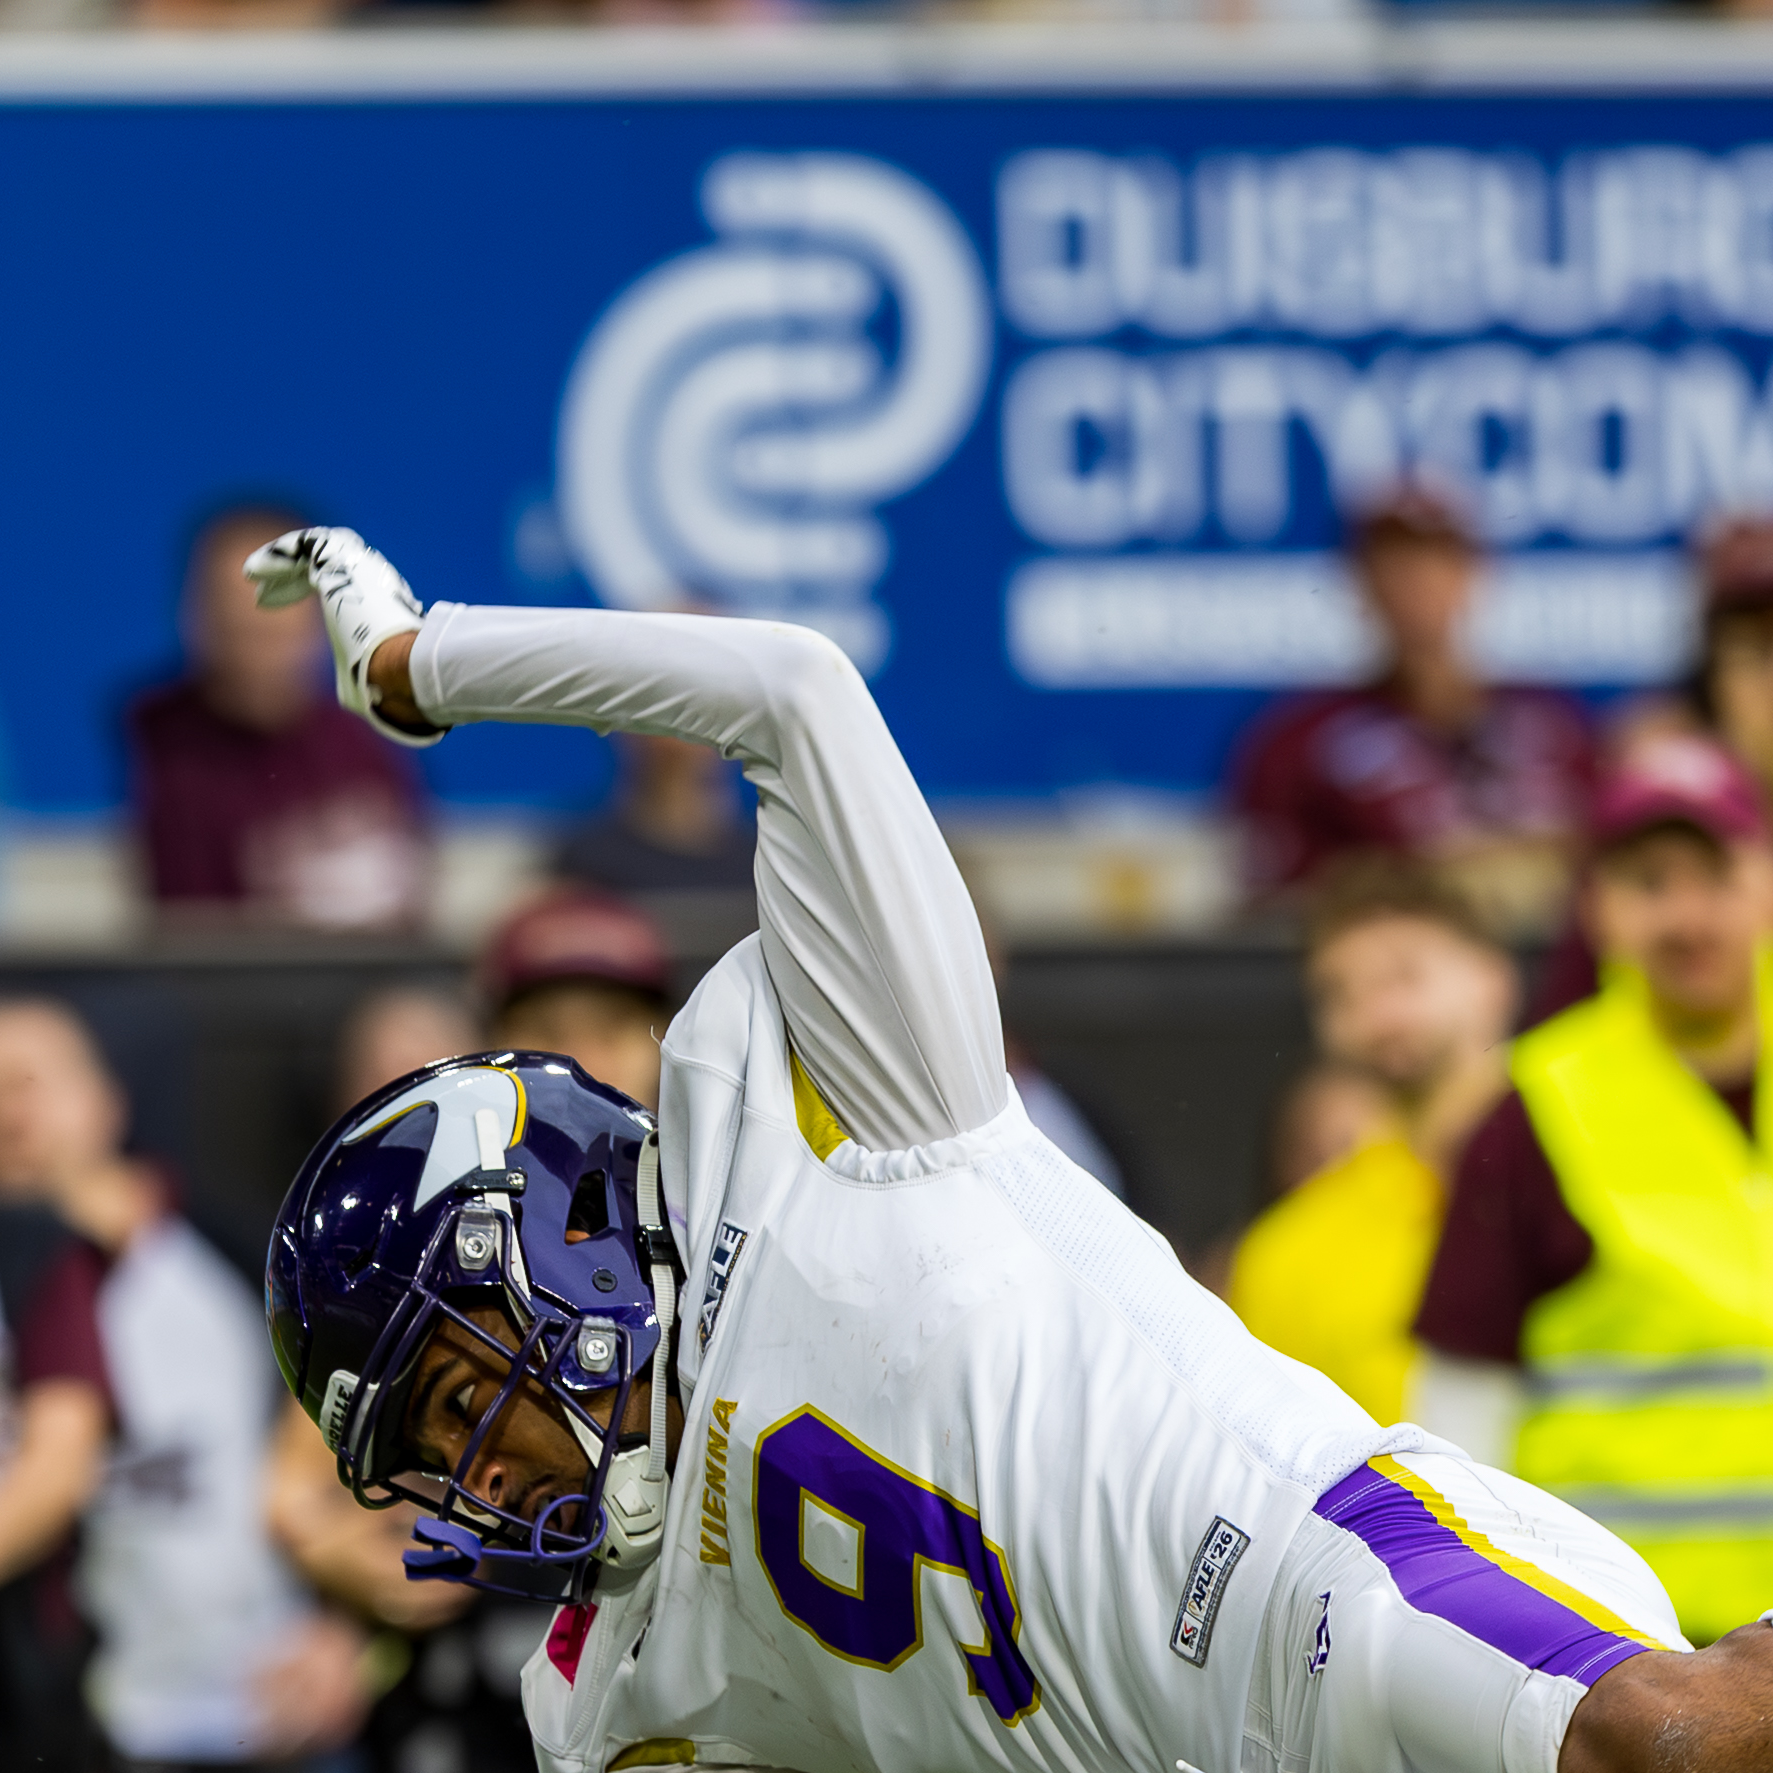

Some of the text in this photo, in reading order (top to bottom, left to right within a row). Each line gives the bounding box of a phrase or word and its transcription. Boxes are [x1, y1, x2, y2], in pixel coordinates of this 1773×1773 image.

[699, 1397, 739, 1568] VIENNA
[752, 1402, 1043, 1729] 9
[1191, 1560, 1216, 1612] AFLE
